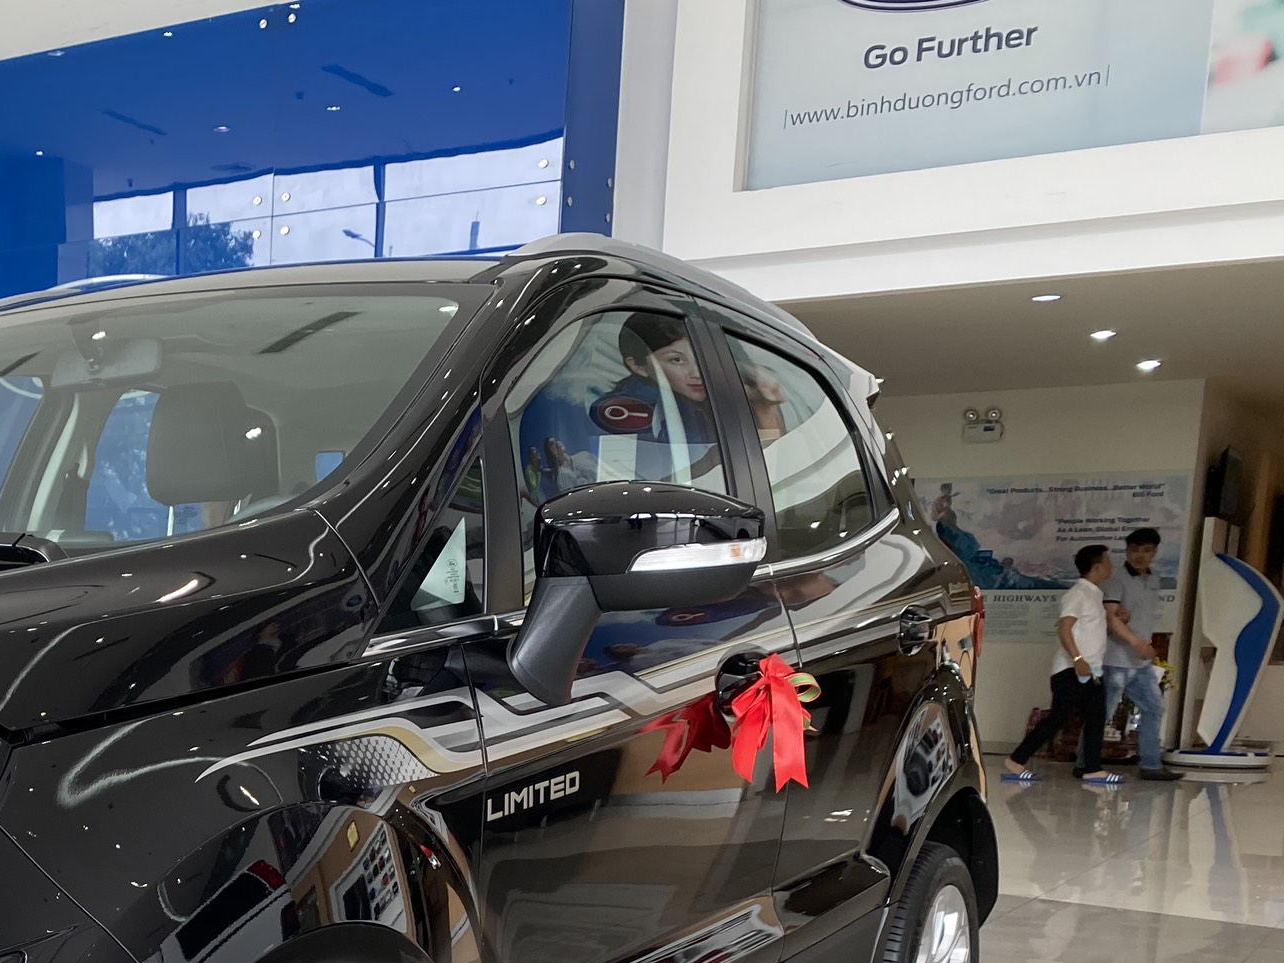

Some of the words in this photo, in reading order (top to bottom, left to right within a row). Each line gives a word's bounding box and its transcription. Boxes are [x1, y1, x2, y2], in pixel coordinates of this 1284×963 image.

[863, 44, 909, 69] Go
[916, 26, 1039, 62] Further
[993, 594, 1058, 602] HIGHWAYS
[487, 770, 580, 822] LIMITED
